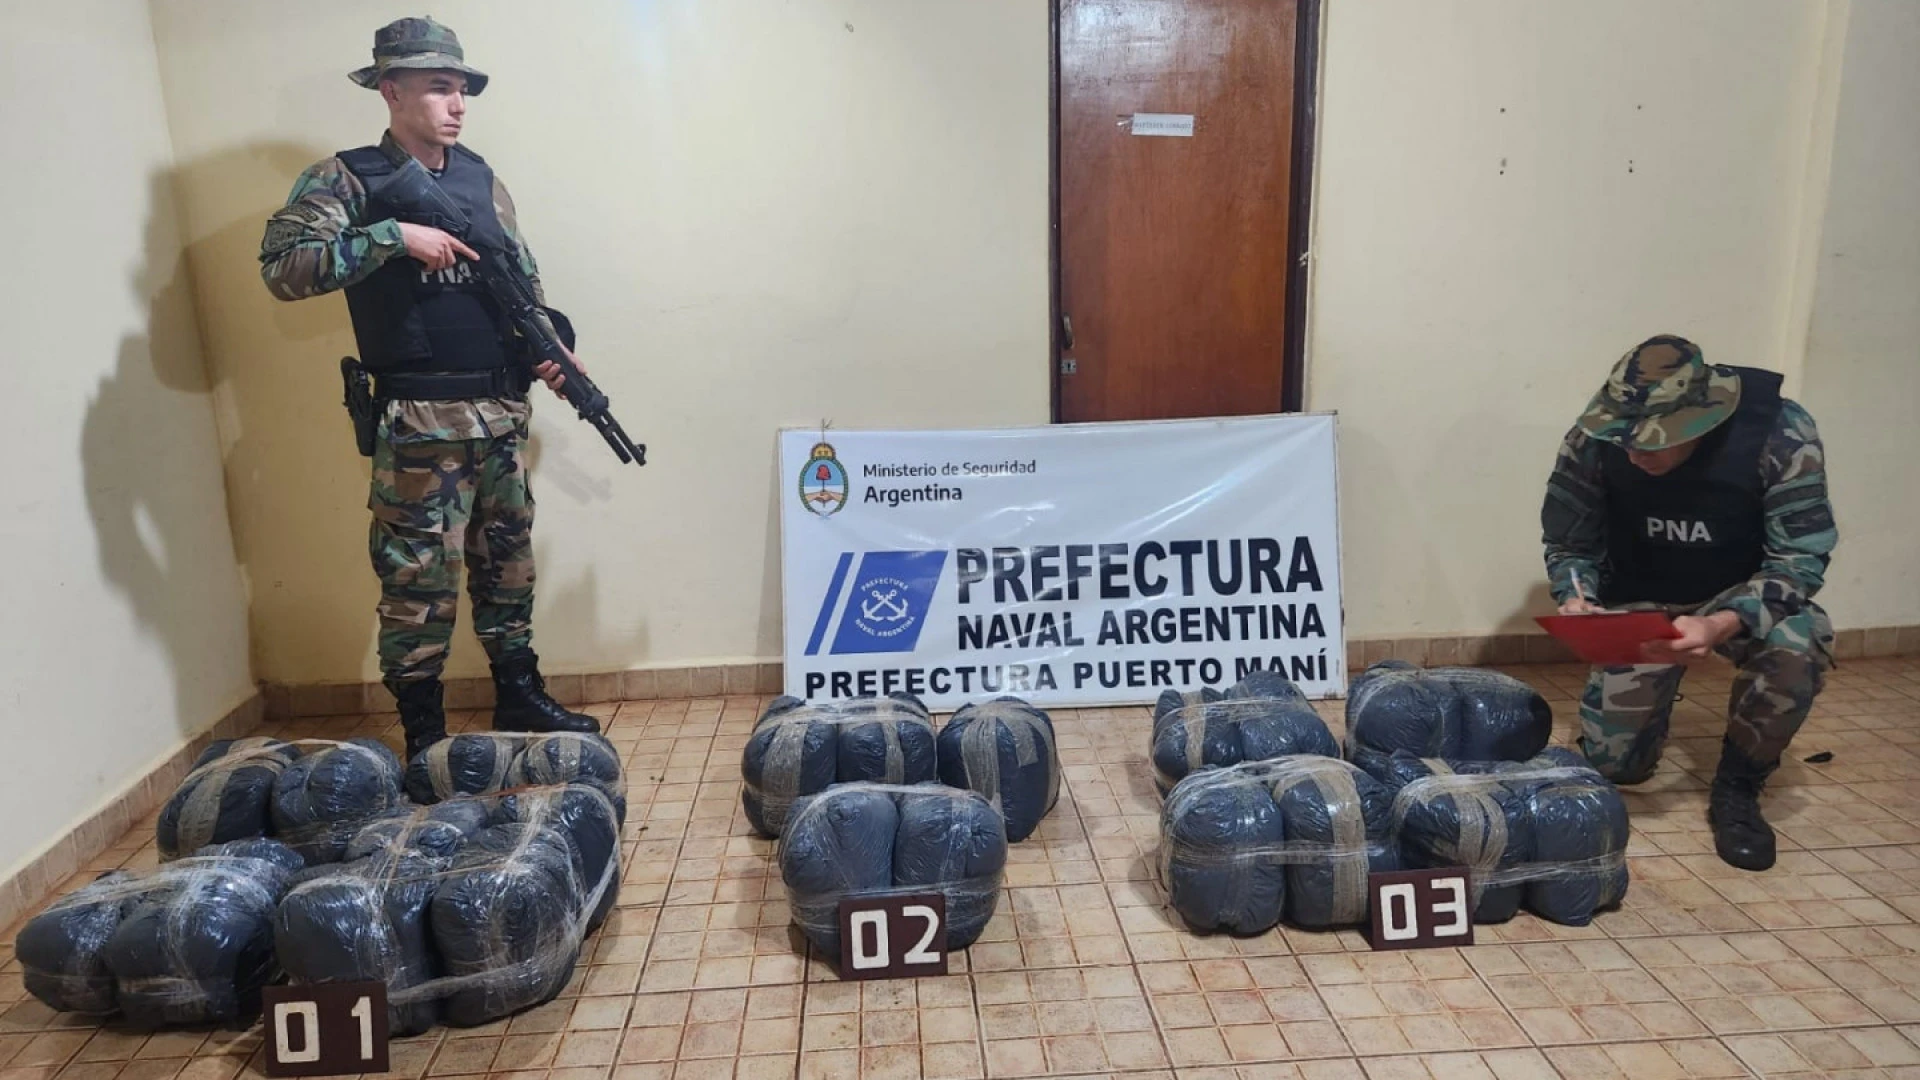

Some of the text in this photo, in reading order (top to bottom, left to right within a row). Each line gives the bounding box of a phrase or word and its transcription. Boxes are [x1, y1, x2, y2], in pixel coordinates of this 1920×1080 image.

[863, 460, 1036, 478] Ministerio de Seguridad
[863, 484, 963, 507] Argentina
[1647, 516, 1712, 542] PNA
[861, 577, 909, 592] PREFECTURA
[956, 536, 1324, 604] PREFECTURA
[957, 603, 1327, 650] NAVAL ARGENTINA
[805, 647, 1328, 699] PREFECTURA PUERTO MANÍ
[1380, 877, 1468, 941] 03
[850, 904, 942, 970] 02
[274, 995, 373, 1063] 01
